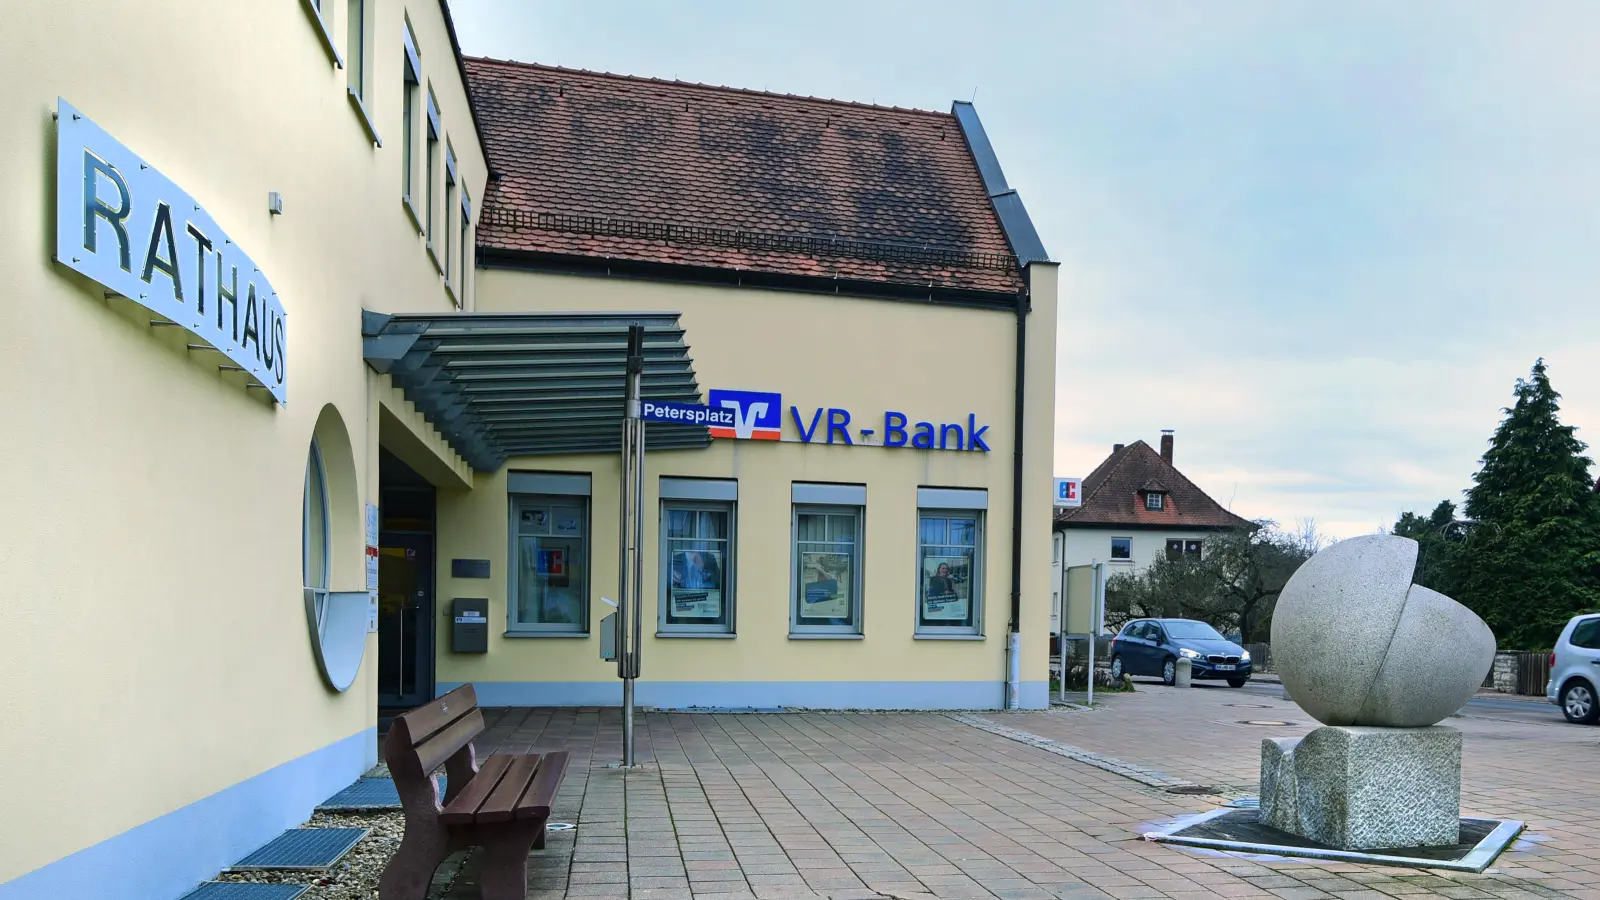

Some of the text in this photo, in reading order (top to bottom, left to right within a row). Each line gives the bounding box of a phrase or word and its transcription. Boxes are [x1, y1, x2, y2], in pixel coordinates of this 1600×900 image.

[83, 145, 284, 385] RATHAUS
[643, 403, 733, 424] Petersplatz
[790, 405, 991, 452] VR-Bank
